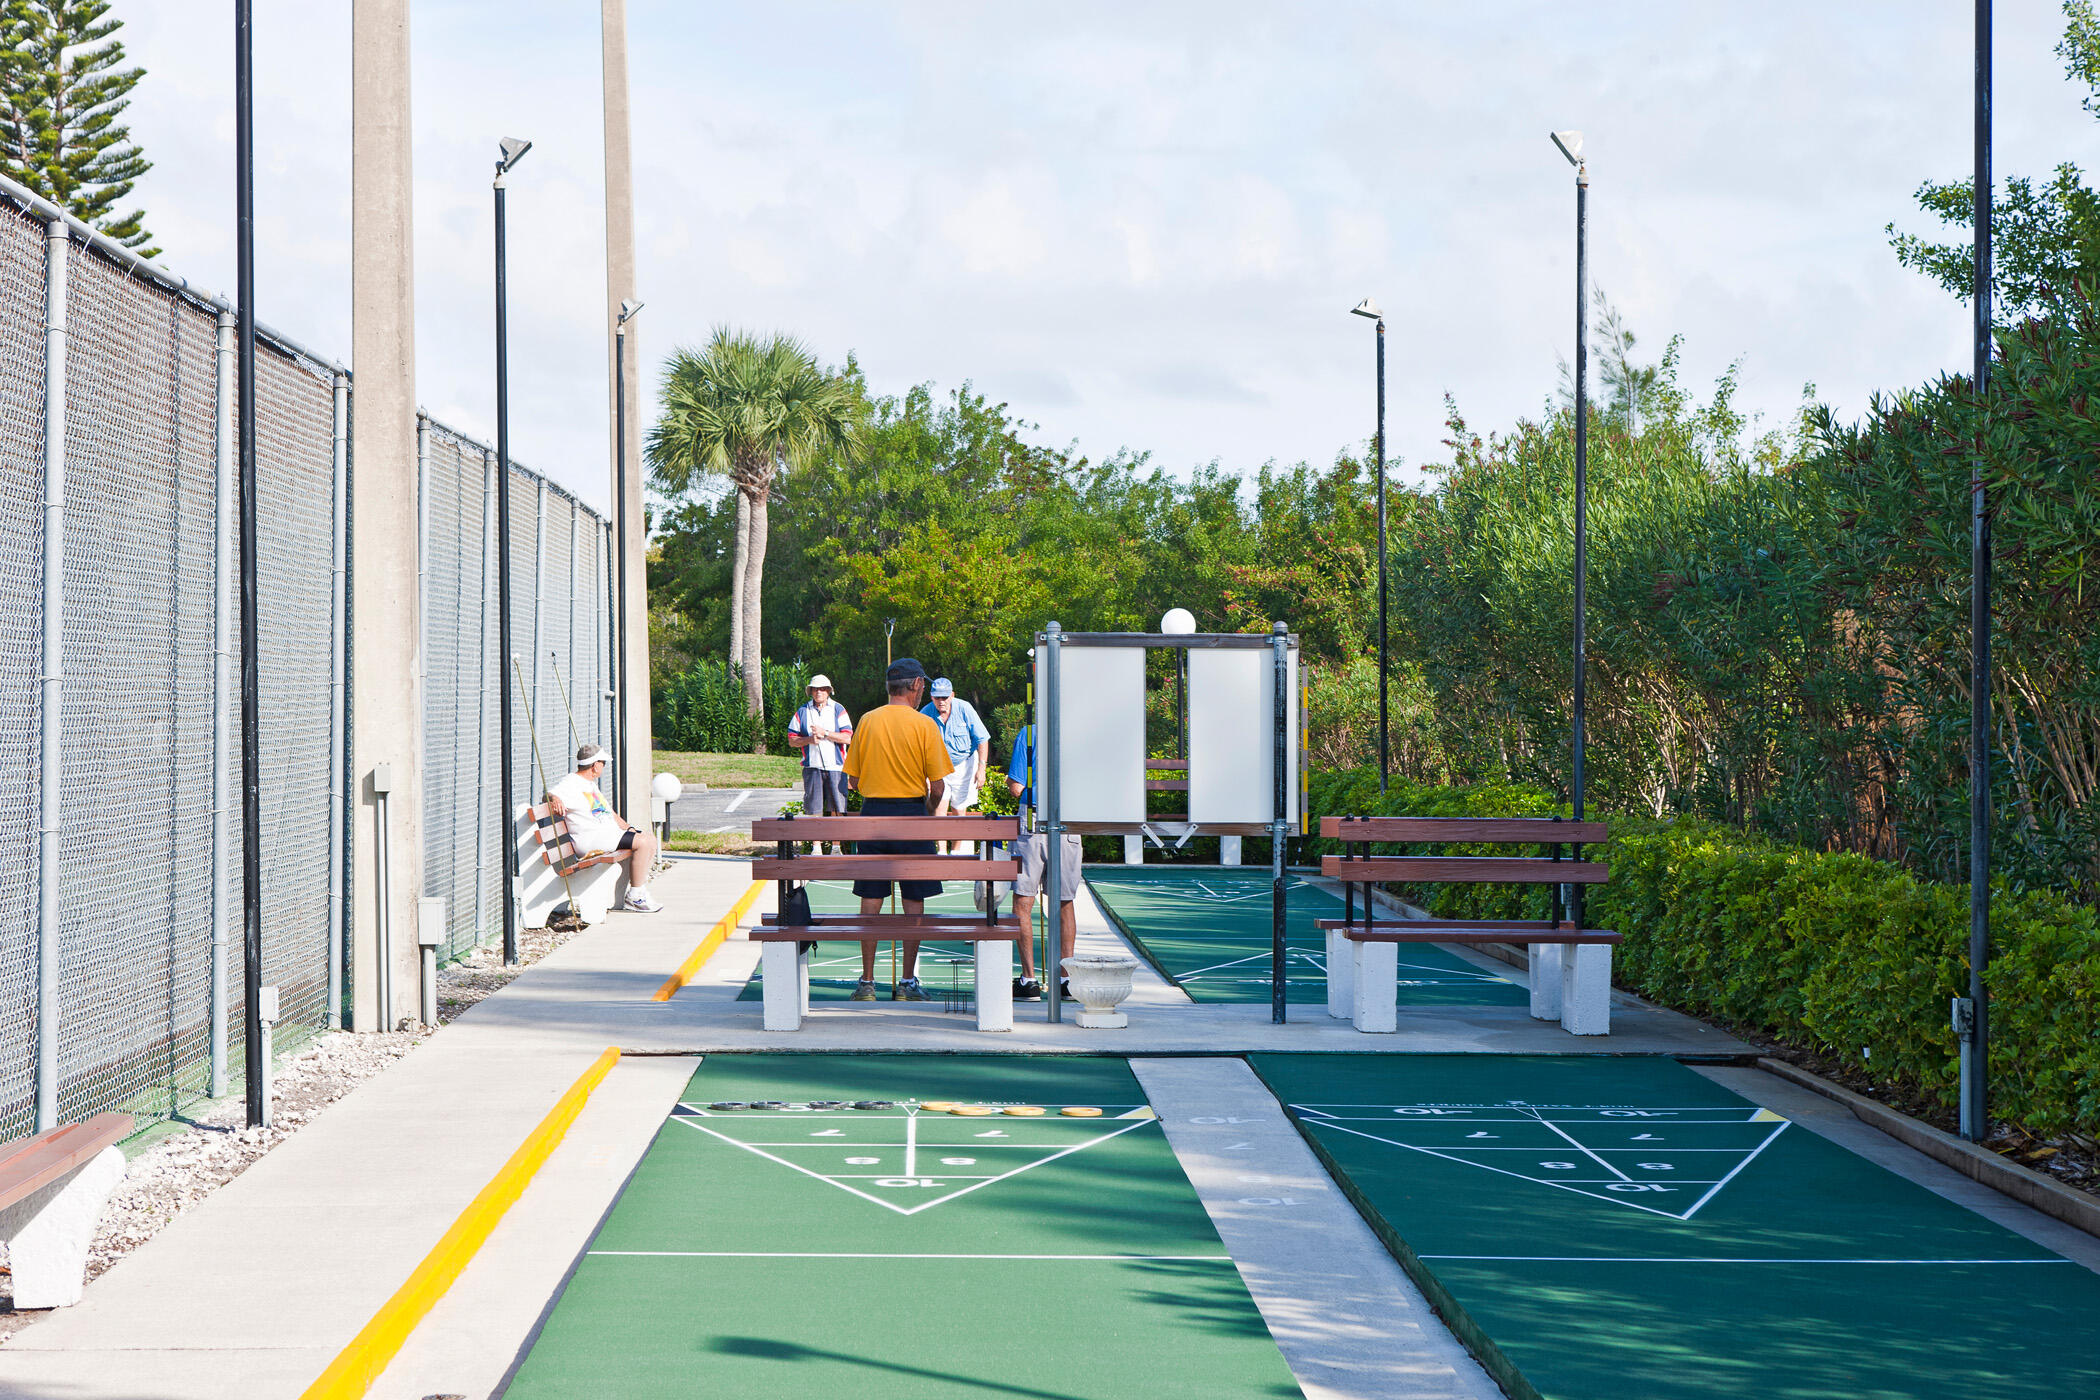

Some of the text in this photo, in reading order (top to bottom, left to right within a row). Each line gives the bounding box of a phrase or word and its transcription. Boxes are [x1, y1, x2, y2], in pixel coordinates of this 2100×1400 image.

[809, 1129, 846, 1137] 7
[973, 1130, 1011, 1138] 7
[1223, 1142, 1257, 1150] 7
[844, 1157, 881, 1165] 8
[940, 1157, 977, 1165] 8
[1538, 1161, 1577, 1169] 8
[1636, 1162, 1675, 1170] 8
[874, 1178, 946, 1187] 10
[1604, 1183, 1679, 1192] 10
[1237, 1197, 1308, 1206] 10
